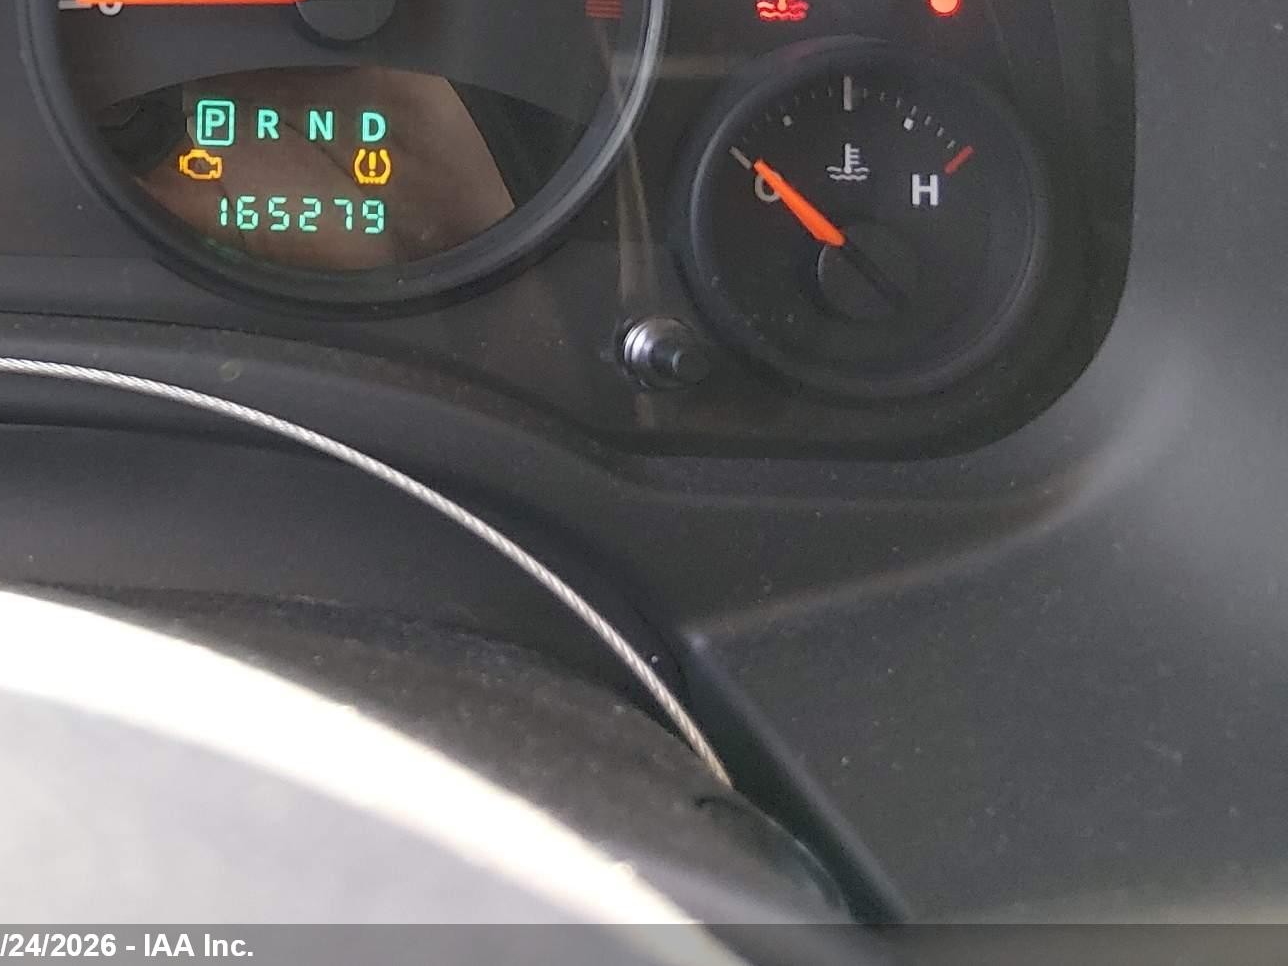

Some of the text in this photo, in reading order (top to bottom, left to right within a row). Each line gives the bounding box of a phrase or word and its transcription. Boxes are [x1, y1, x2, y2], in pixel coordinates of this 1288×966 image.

[206, 109, 386, 142] P R N D
[912, 174, 939, 206] H
[219, 196, 385, 233] 165279
